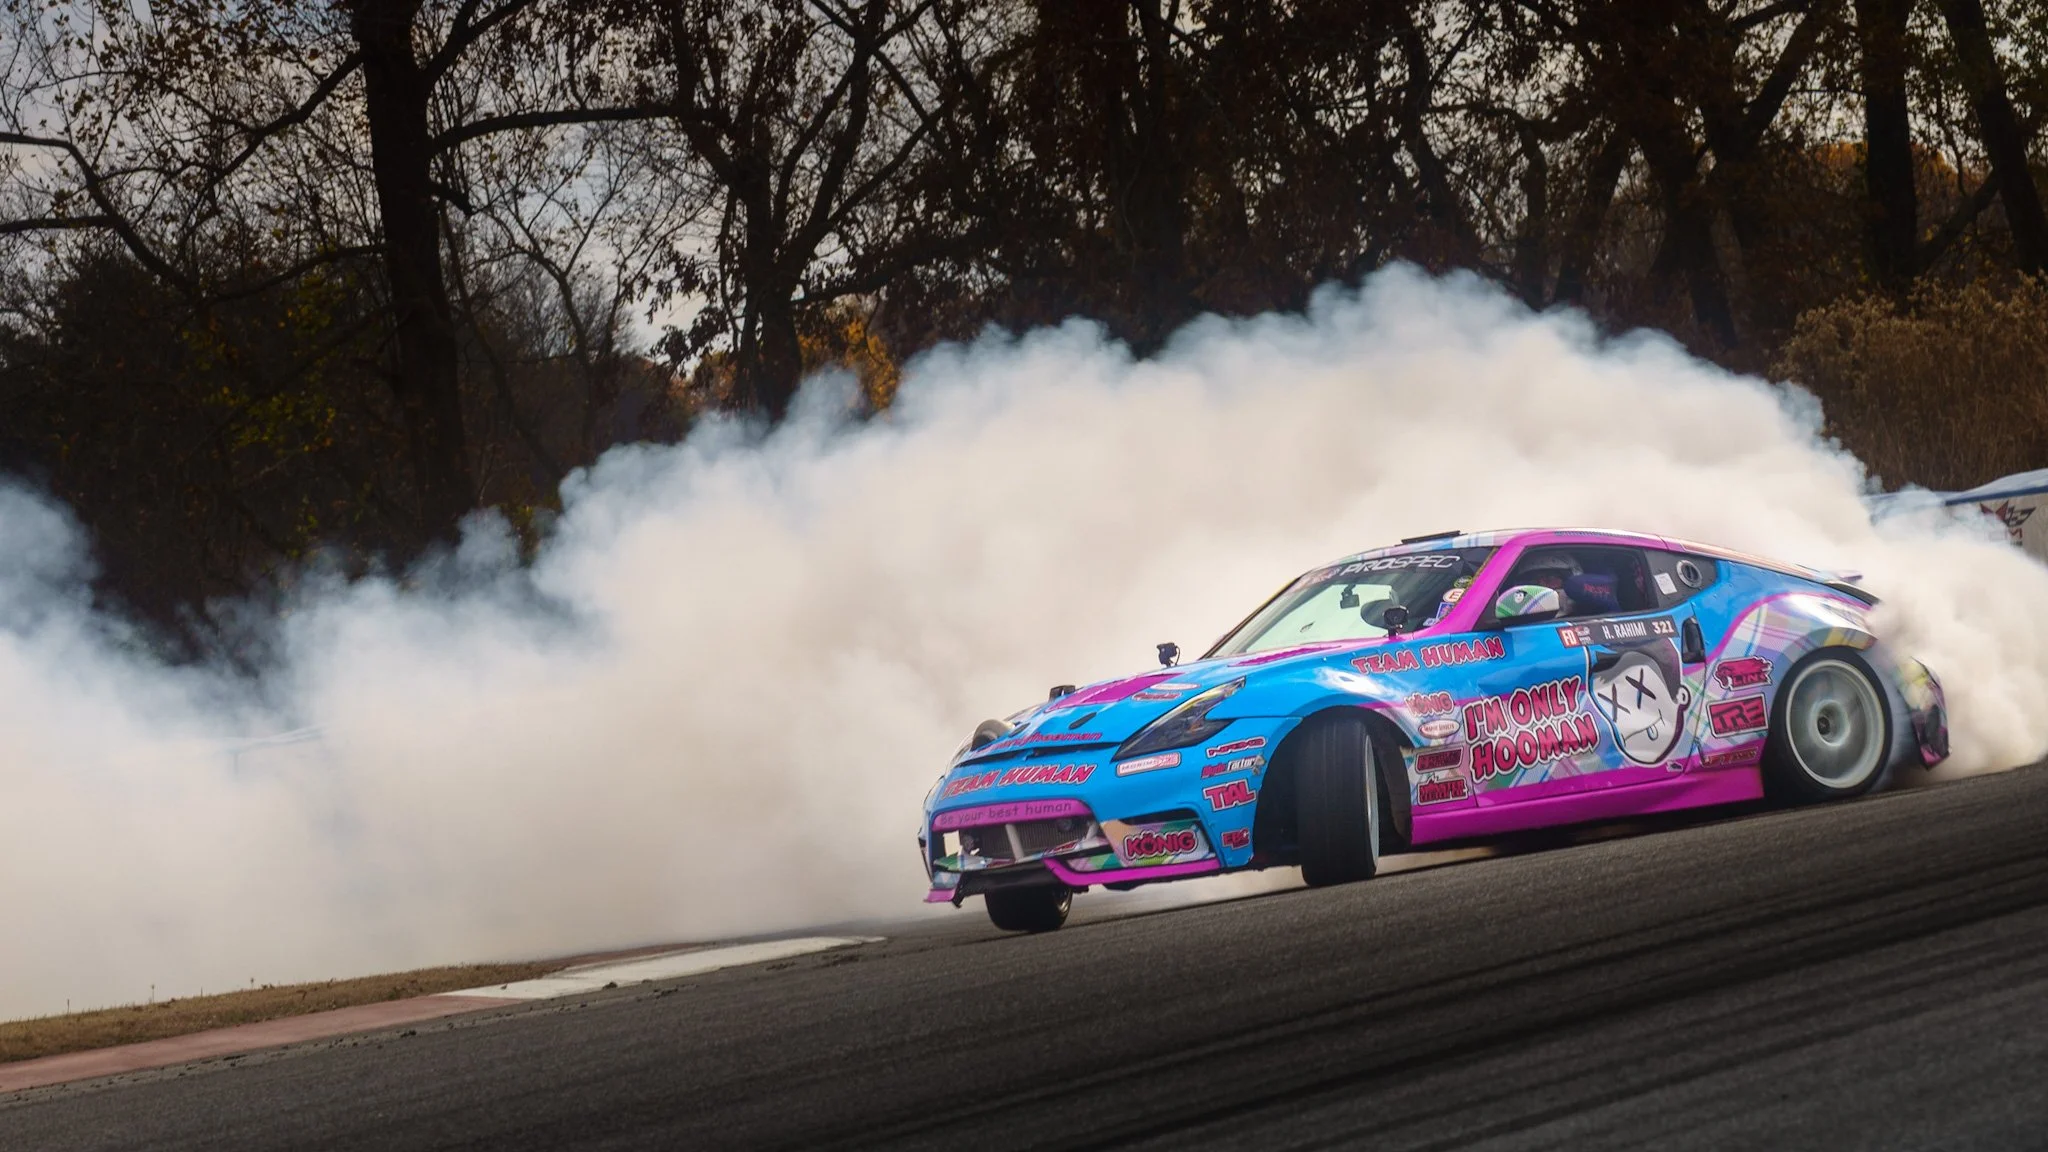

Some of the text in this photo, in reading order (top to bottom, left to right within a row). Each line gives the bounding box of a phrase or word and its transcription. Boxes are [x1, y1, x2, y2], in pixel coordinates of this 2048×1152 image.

[1340, 555, 1461, 577] PROSPEC
[1561, 629, 1578, 647] FD
[1602, 624, 1615, 640] H.
[1614, 621, 1647, 640] RAHIMI
[1651, 620, 1675, 635] 321
[1351, 637, 1504, 675] TEAM HUMAN
[1464, 677, 1580, 740] I'M ONLY
[1472, 713, 1599, 780] HOOMAN
[943, 764, 1096, 800] TEAM HUMAN
[958, 811, 984, 824] your
[988, 806, 1019, 819] best
[1025, 802, 1072, 815] human
